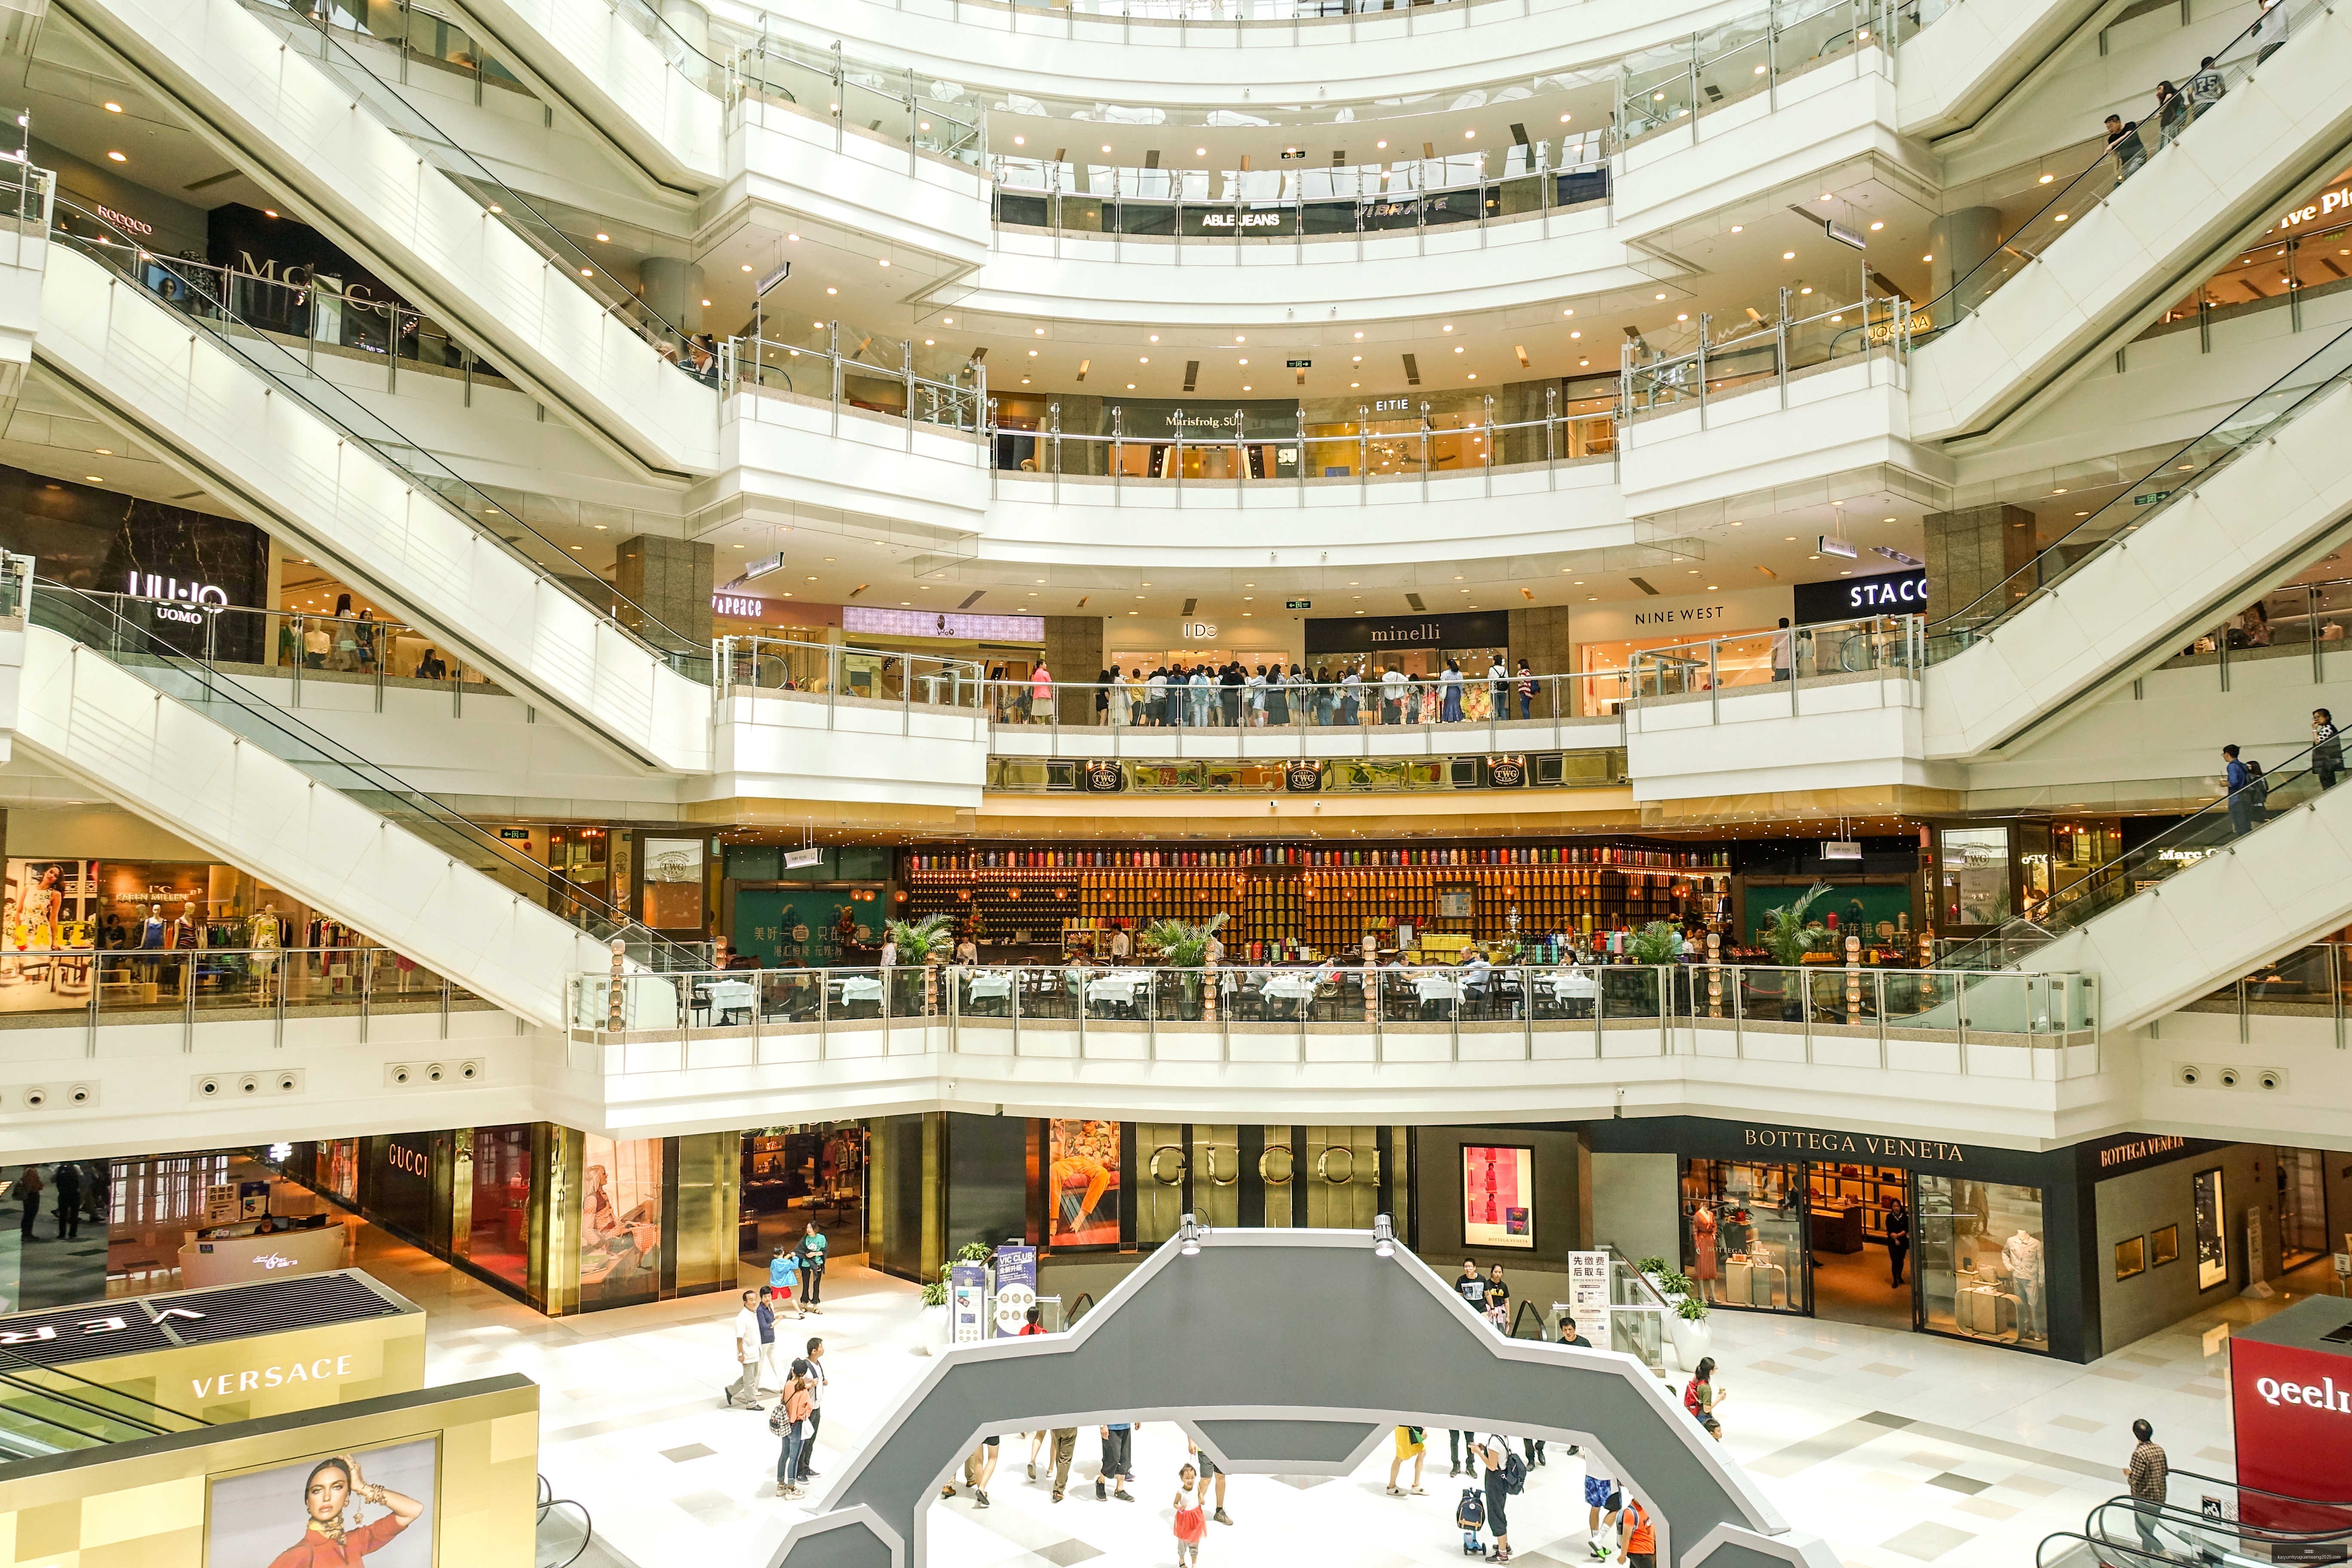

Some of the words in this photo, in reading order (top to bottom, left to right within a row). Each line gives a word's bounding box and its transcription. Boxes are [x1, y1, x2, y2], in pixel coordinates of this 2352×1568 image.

[98, 205, 153, 235] ROCOCO
[1202, 214, 1235, 226] ABLE
[1238, 214, 1280, 226] JEANS
[2266, 205, 2317, 234] ive
[1376, 399, 1408, 411] EITIE
[1278, 448, 1297, 463] SU
[1850, 545, 1856, 554] L3
[772, 555, 778, 564] L3
[156, 607, 202, 624] UOMO
[1636, 611, 1673, 625] NINE
[1680, 606, 1723, 620] WEST
[1185, 624, 1189, 636] I
[1195, 624, 1217, 636] Do
[1371, 624, 1440, 641] minelli
[1962, 854, 1987, 863] TWG
[2158, 849, 2202, 860] Marc
[116, 894, 148, 902] KAREN
[151, 894, 187, 902] MILLEN
[14, 924, 86, 946] SALE
[1246, 949, 1250, 958] 1
[1264, 949, 1268, 958] 3
[1273, 949, 1277, 958] 7
[1745, 1129, 1856, 1152] BOTTEGA
[1865, 1137, 1964, 1162] VENETA
[2101, 1141, 2147, 1167] BOTTEGA
[2148, 1136, 2184, 1155] VENETA
[389, 1144, 427, 1178] GUCCI
[1150, 1146, 1381, 1187] GUCCI
[1708, 1246, 1743, 1254] BOTTEGA
[1013, 1252, 1032, 1262] CLUB
[1574, 1256, 1605, 1265] 先缴费
[999, 1265, 1022, 1274] 全新升级
[1574, 1268, 1605, 1276] 后取车
[192, 1355, 352, 1399] VERSACE
